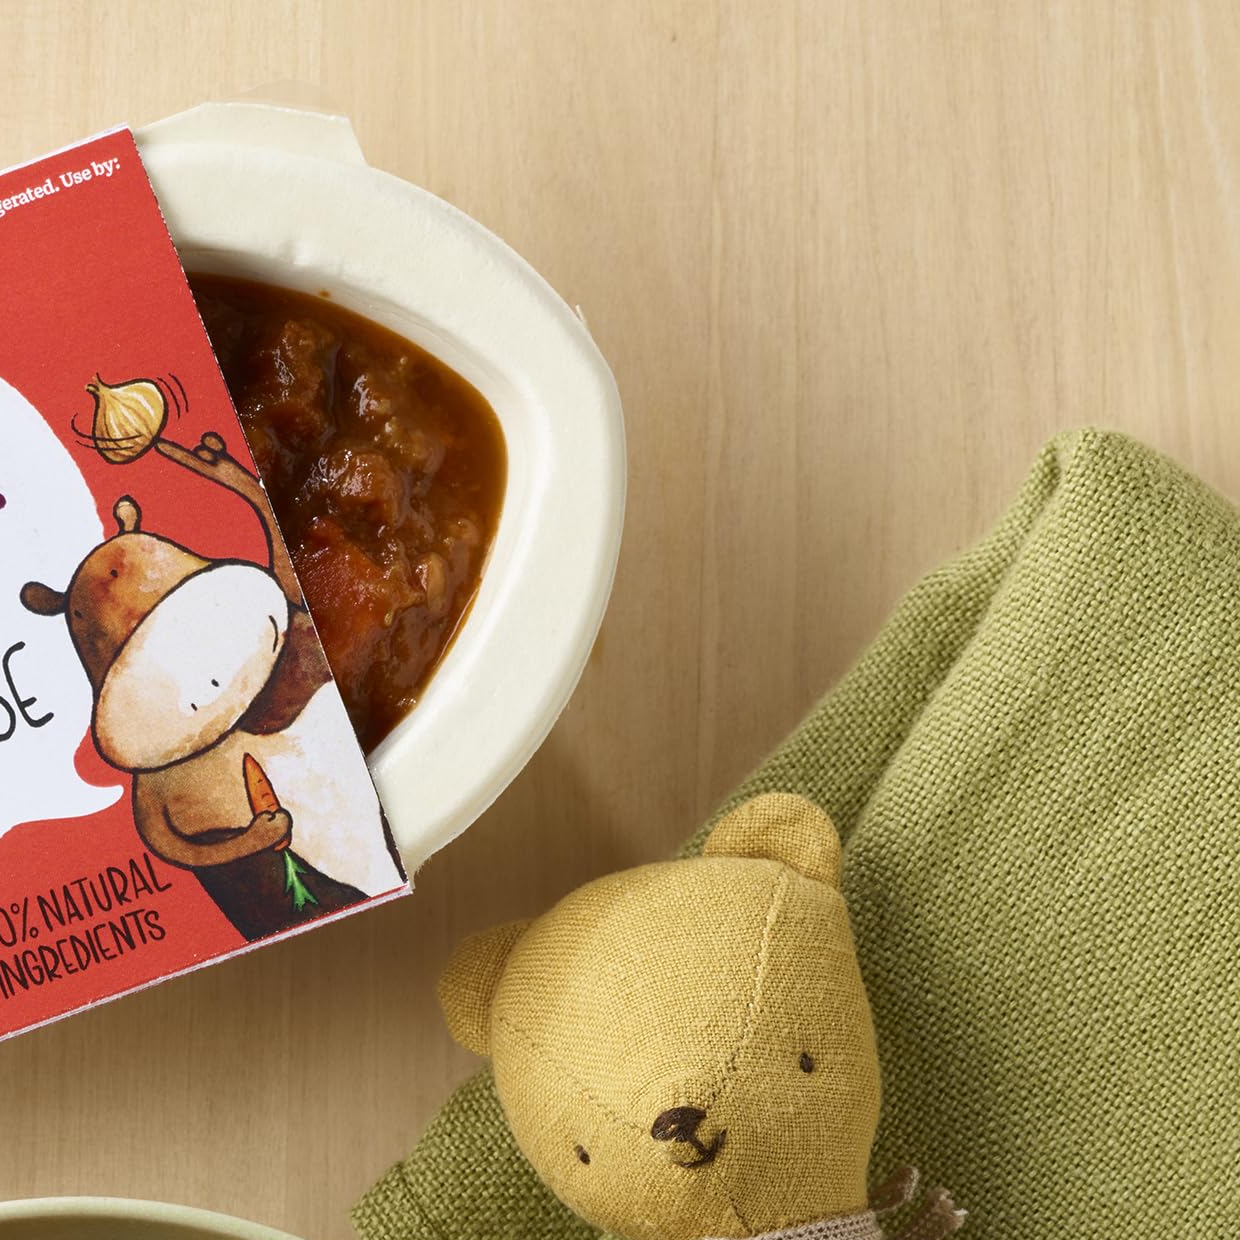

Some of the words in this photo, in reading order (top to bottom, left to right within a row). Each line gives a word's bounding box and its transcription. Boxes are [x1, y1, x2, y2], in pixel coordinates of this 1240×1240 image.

[59, 166, 93, 188] Use
[91, 157, 121, 183] by:
[37, 852, 172, 932] NATURAL
